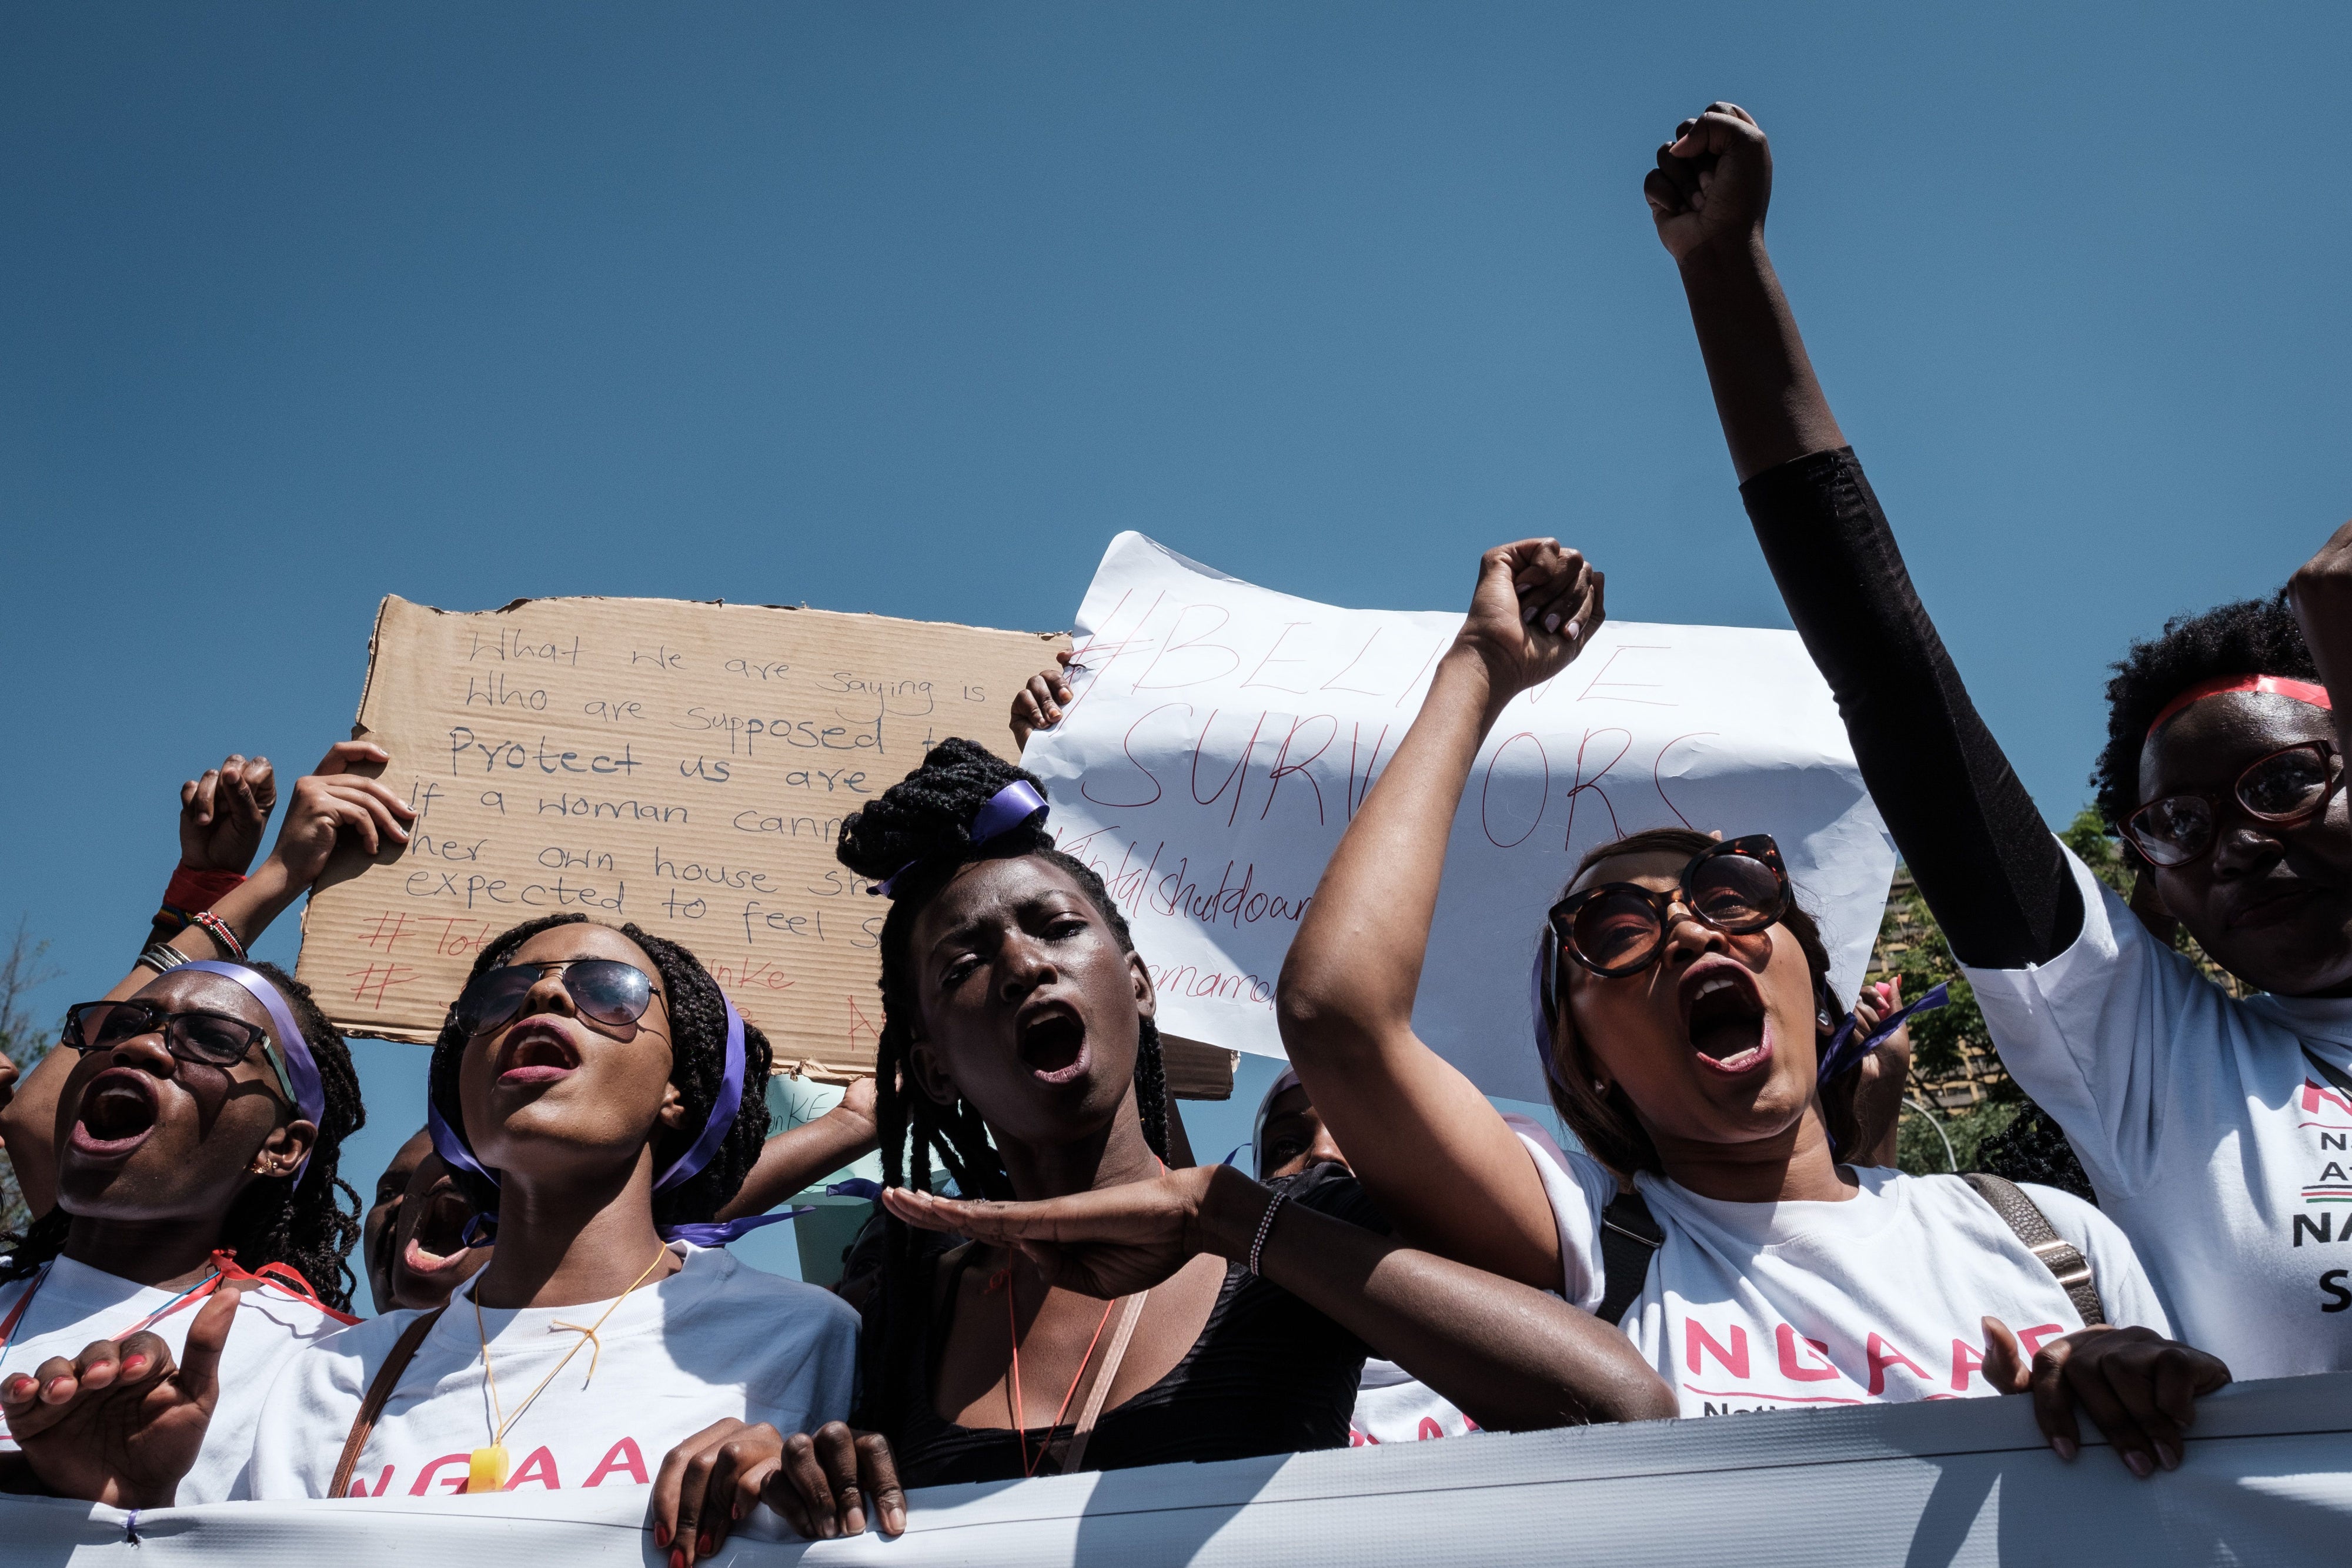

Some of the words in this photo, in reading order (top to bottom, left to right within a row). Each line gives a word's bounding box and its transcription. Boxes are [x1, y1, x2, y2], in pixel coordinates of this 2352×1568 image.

[466, 670, 547, 710] Who
[584, 700, 647, 723] are
[470, 627, 589, 666] What
[724, 657, 789, 680] are
[960, 680, 985, 702] is
[449, 726, 642, 777] Protect
[680, 754, 730, 783] us
[786, 768, 873, 793] are
[480, 790, 505, 816] a
[412, 813, 489, 861] her
[538, 847, 613, 871] own
[654, 846, 779, 893] house
[406, 871, 624, 915] expected
[662, 888, 707, 919] to
[742, 901, 825, 945] feel
